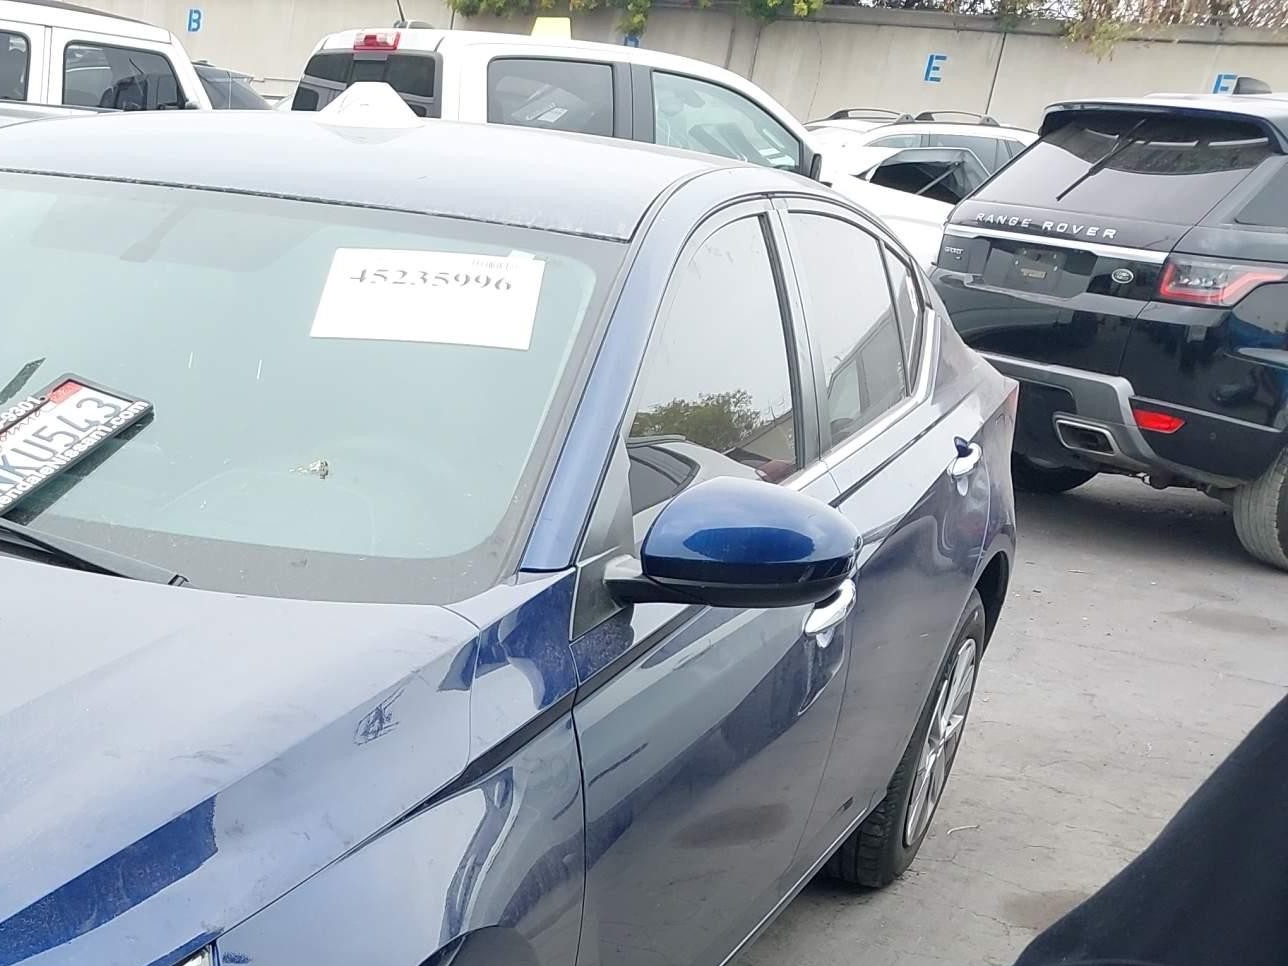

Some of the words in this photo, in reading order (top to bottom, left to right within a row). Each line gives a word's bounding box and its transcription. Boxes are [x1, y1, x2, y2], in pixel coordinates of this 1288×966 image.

[187, 8, 202, 33] B
[923, 53, 948, 83] E
[975, 212, 1032, 228] RANGE
[1041, 221, 1118, 239] ROVER
[349, 268, 512, 291] 45235996
